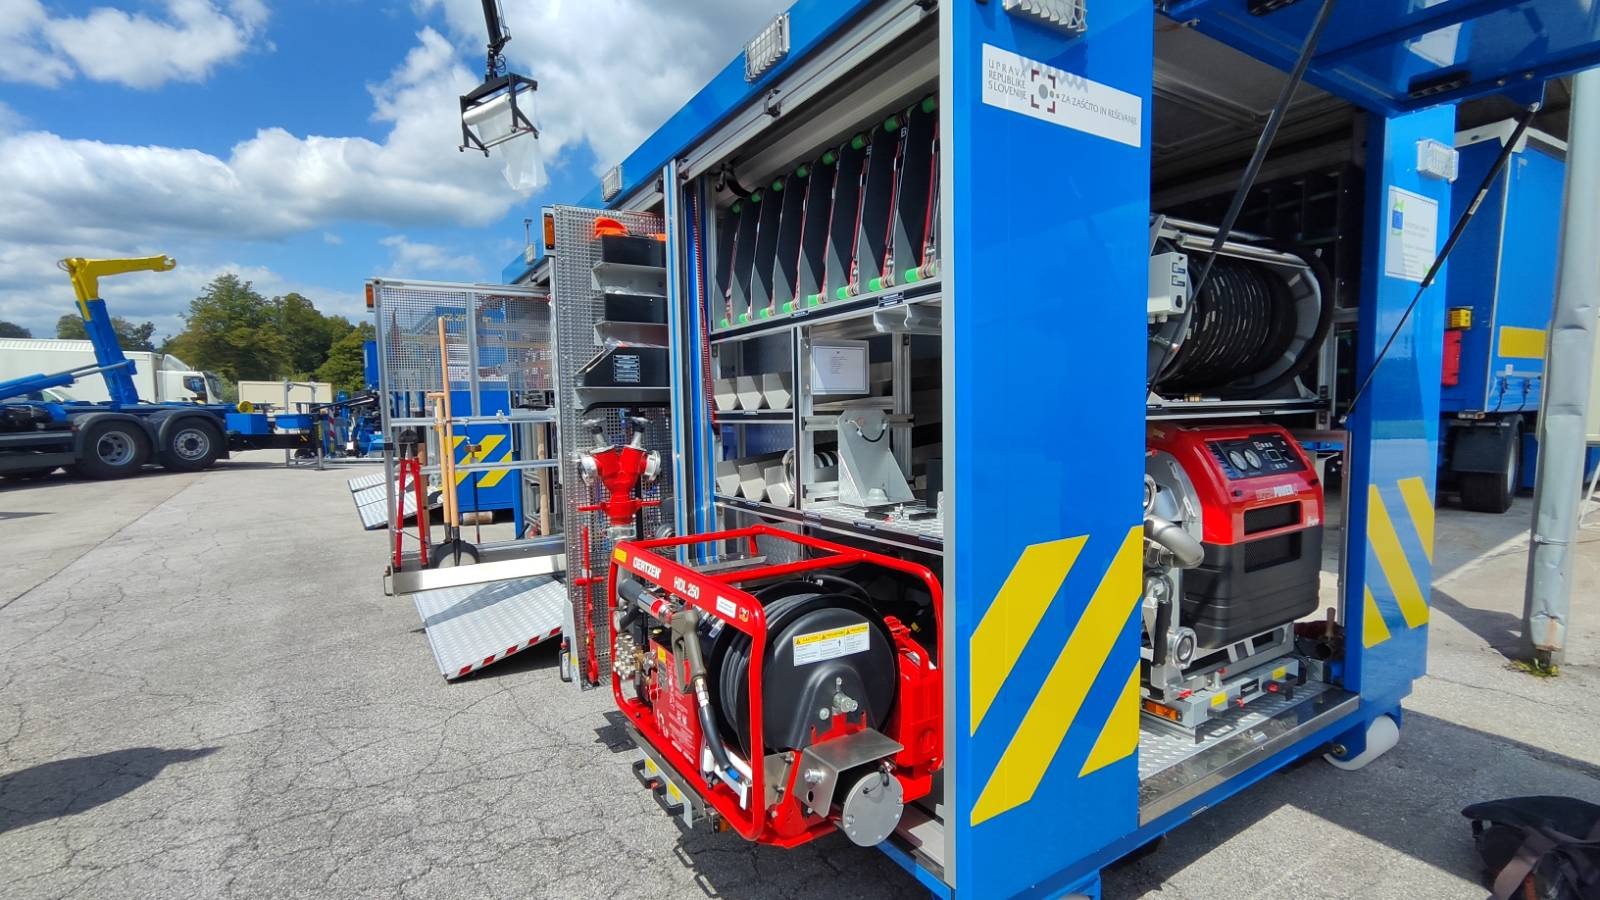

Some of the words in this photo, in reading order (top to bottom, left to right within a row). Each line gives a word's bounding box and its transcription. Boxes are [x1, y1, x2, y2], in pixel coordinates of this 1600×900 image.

[989, 59, 1026, 78] UPRAVA
[988, 80, 1027, 99] SLOVENIJE
[989, 70, 1025, 89] REPUBLIKE
[1062, 94, 1071, 104] ZA
[1100, 105, 1107, 116] IN
[633, 557, 661, 579] OERTZEN
[674, 576, 687, 593] HDL
[688, 583, 700, 600] 250
